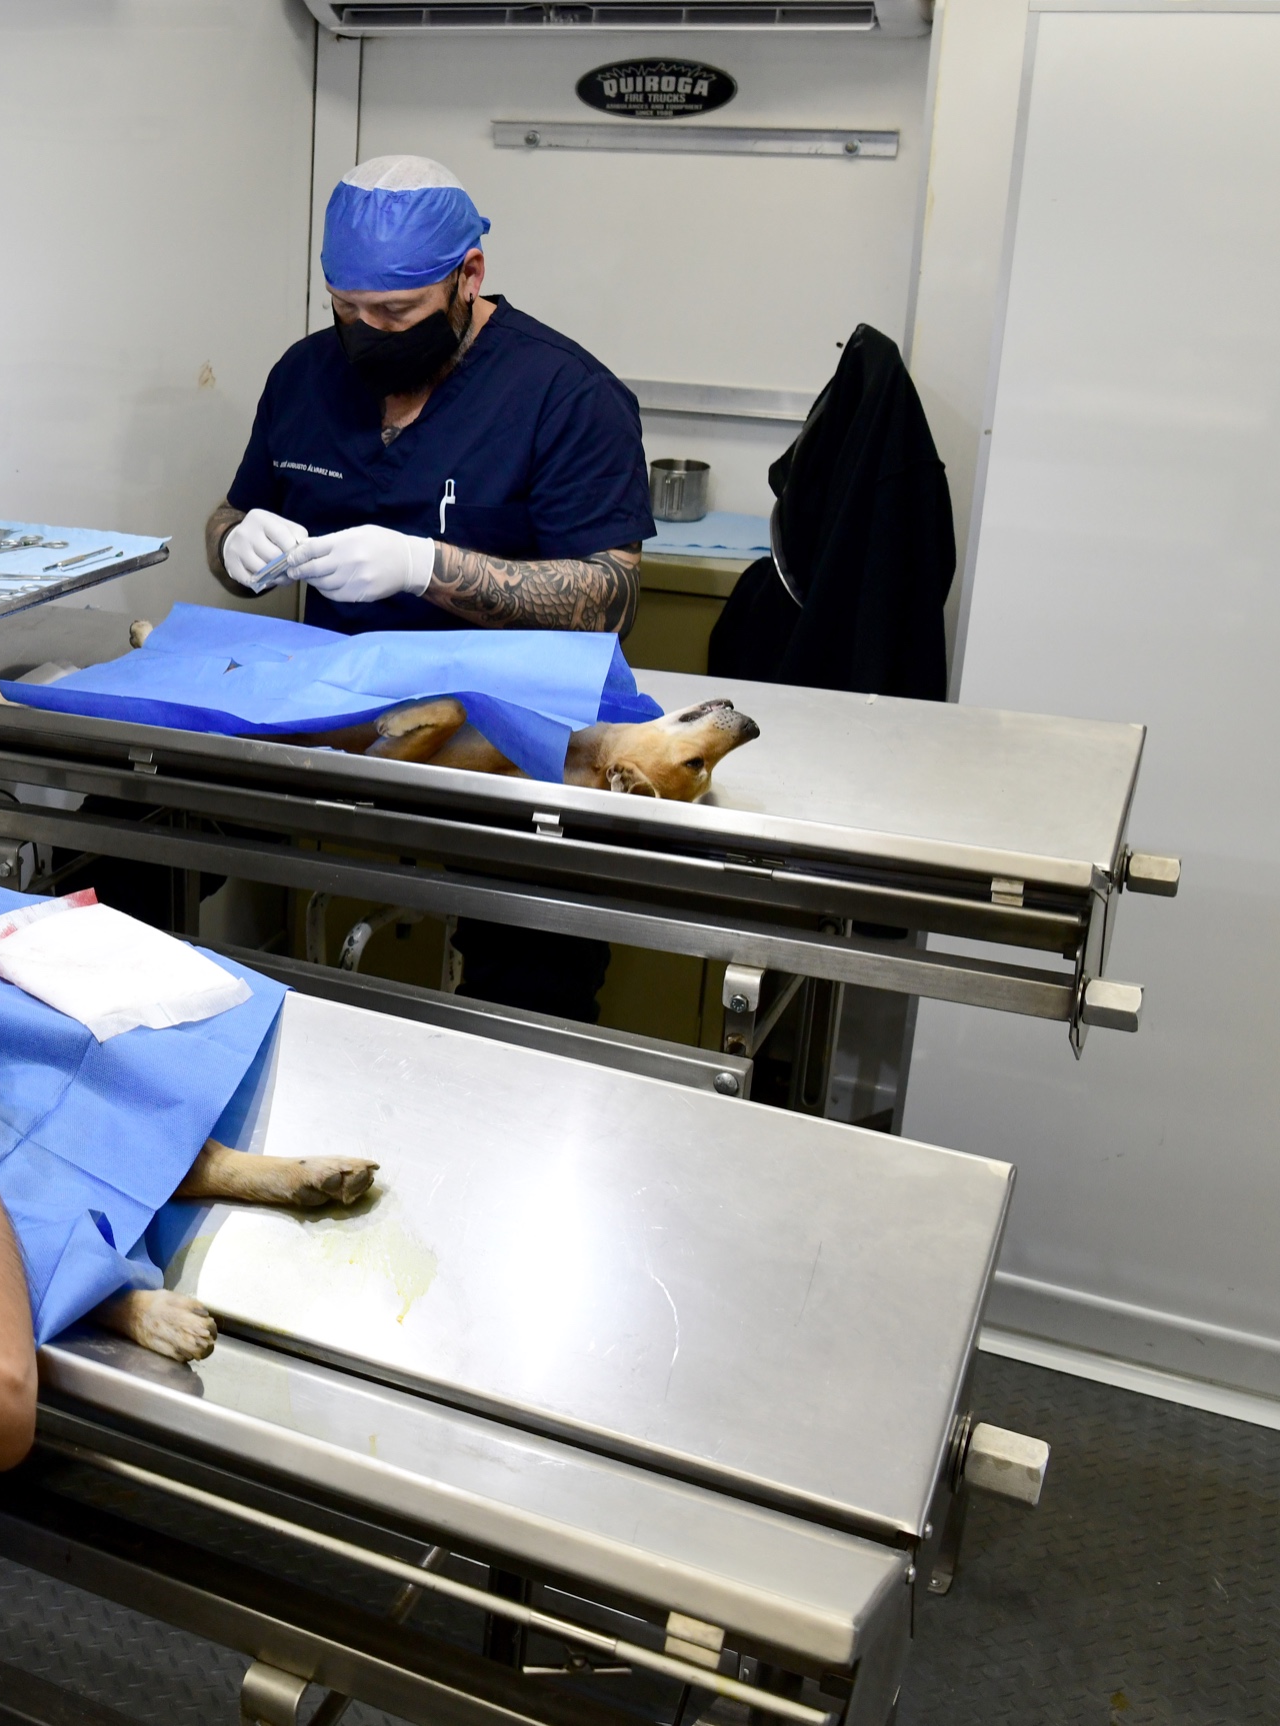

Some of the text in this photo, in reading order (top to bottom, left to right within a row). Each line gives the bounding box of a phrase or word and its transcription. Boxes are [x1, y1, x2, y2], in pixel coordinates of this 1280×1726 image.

[603, 76, 709, 98] QUIROGA
[624, 93, 686, 103] FIRE TRUCKS
[287, 462, 308, 471] AUGUSTO
[307, 464, 329, 476] ÁLVAREZ
[328, 470, 343, 479] MORA
